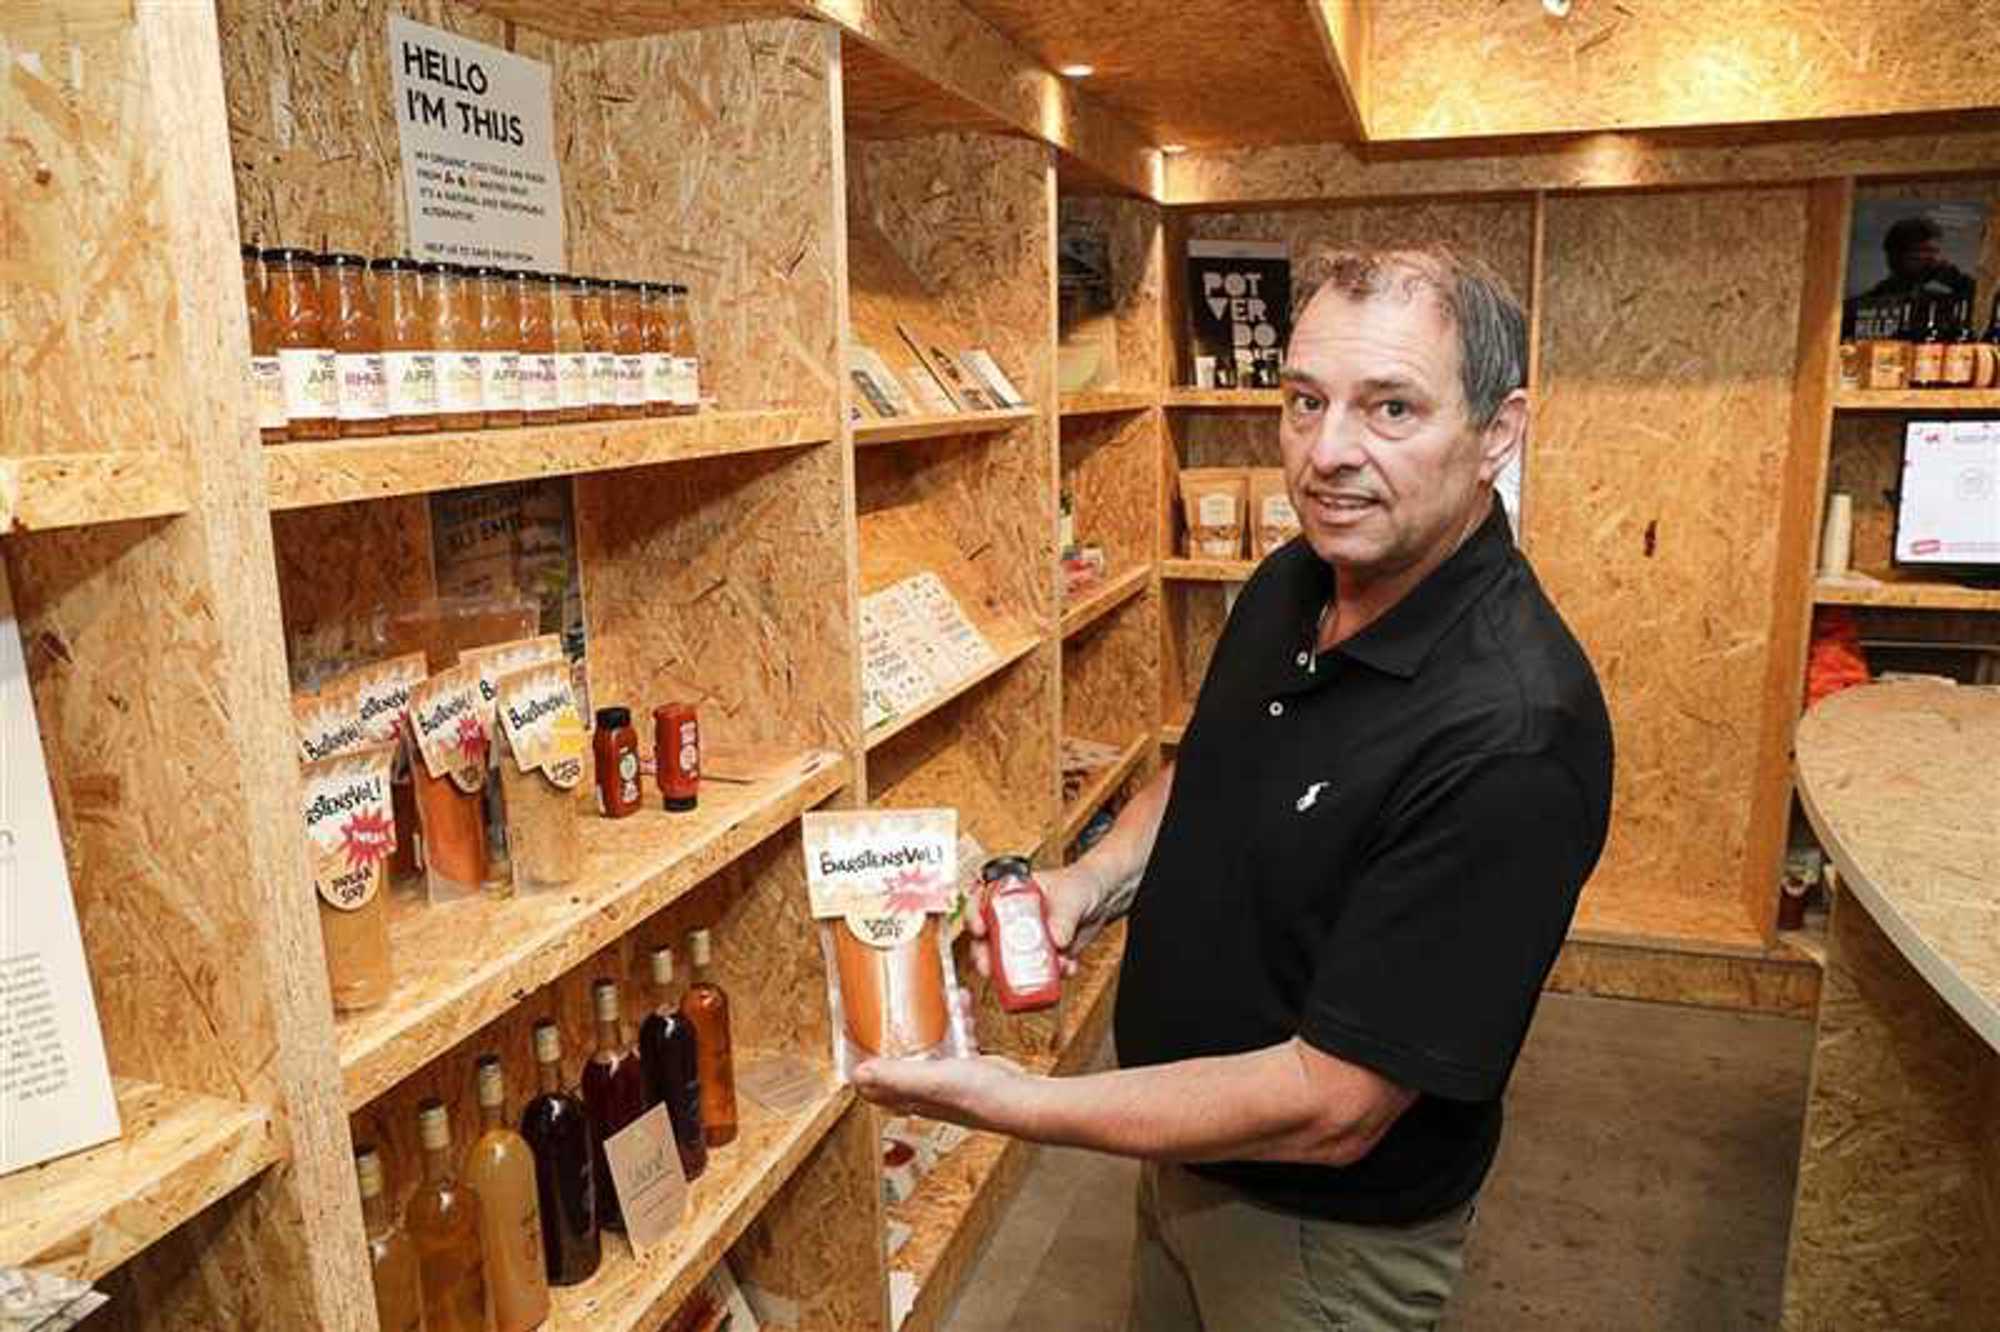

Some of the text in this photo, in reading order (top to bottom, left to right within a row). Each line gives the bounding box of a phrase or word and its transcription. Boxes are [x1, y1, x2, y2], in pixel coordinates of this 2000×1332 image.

[402, 41, 489, 95] HELLO
[406, 87, 448, 129] I'M
[1202, 272, 1262, 297] POT
[1206, 297, 1267, 323] VER
[1232, 322, 1277, 347] DO
